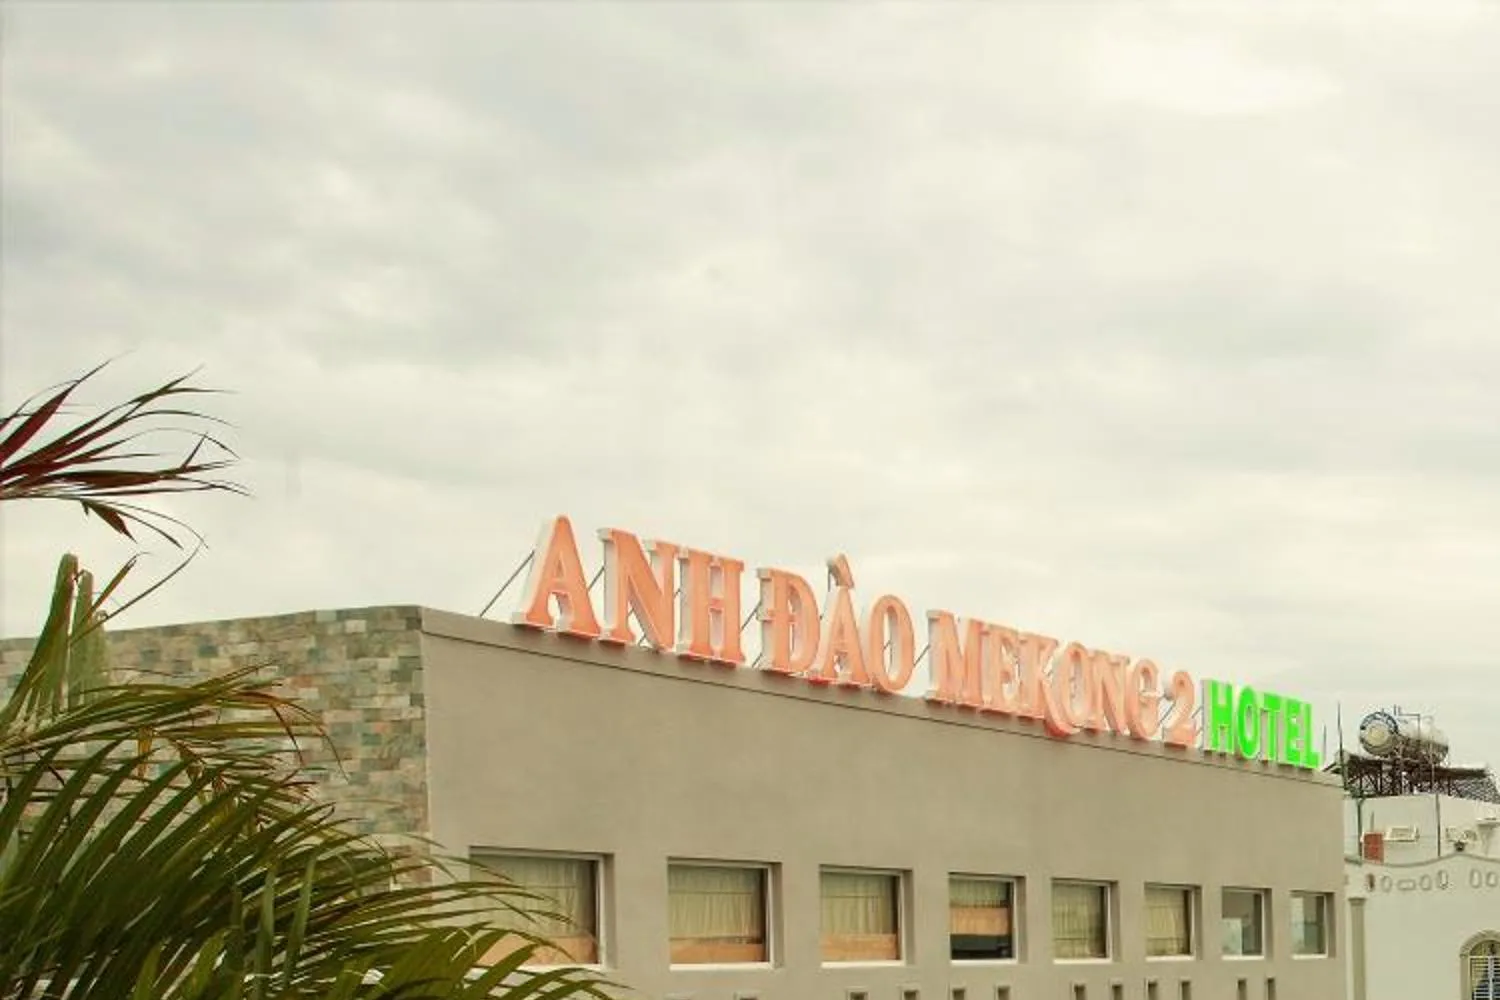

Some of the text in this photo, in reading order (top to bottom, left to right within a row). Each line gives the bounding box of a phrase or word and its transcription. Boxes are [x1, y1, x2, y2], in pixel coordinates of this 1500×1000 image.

[513, 515, 1321, 768] ANH ĐÀO MEKONG 2 HOTEL
